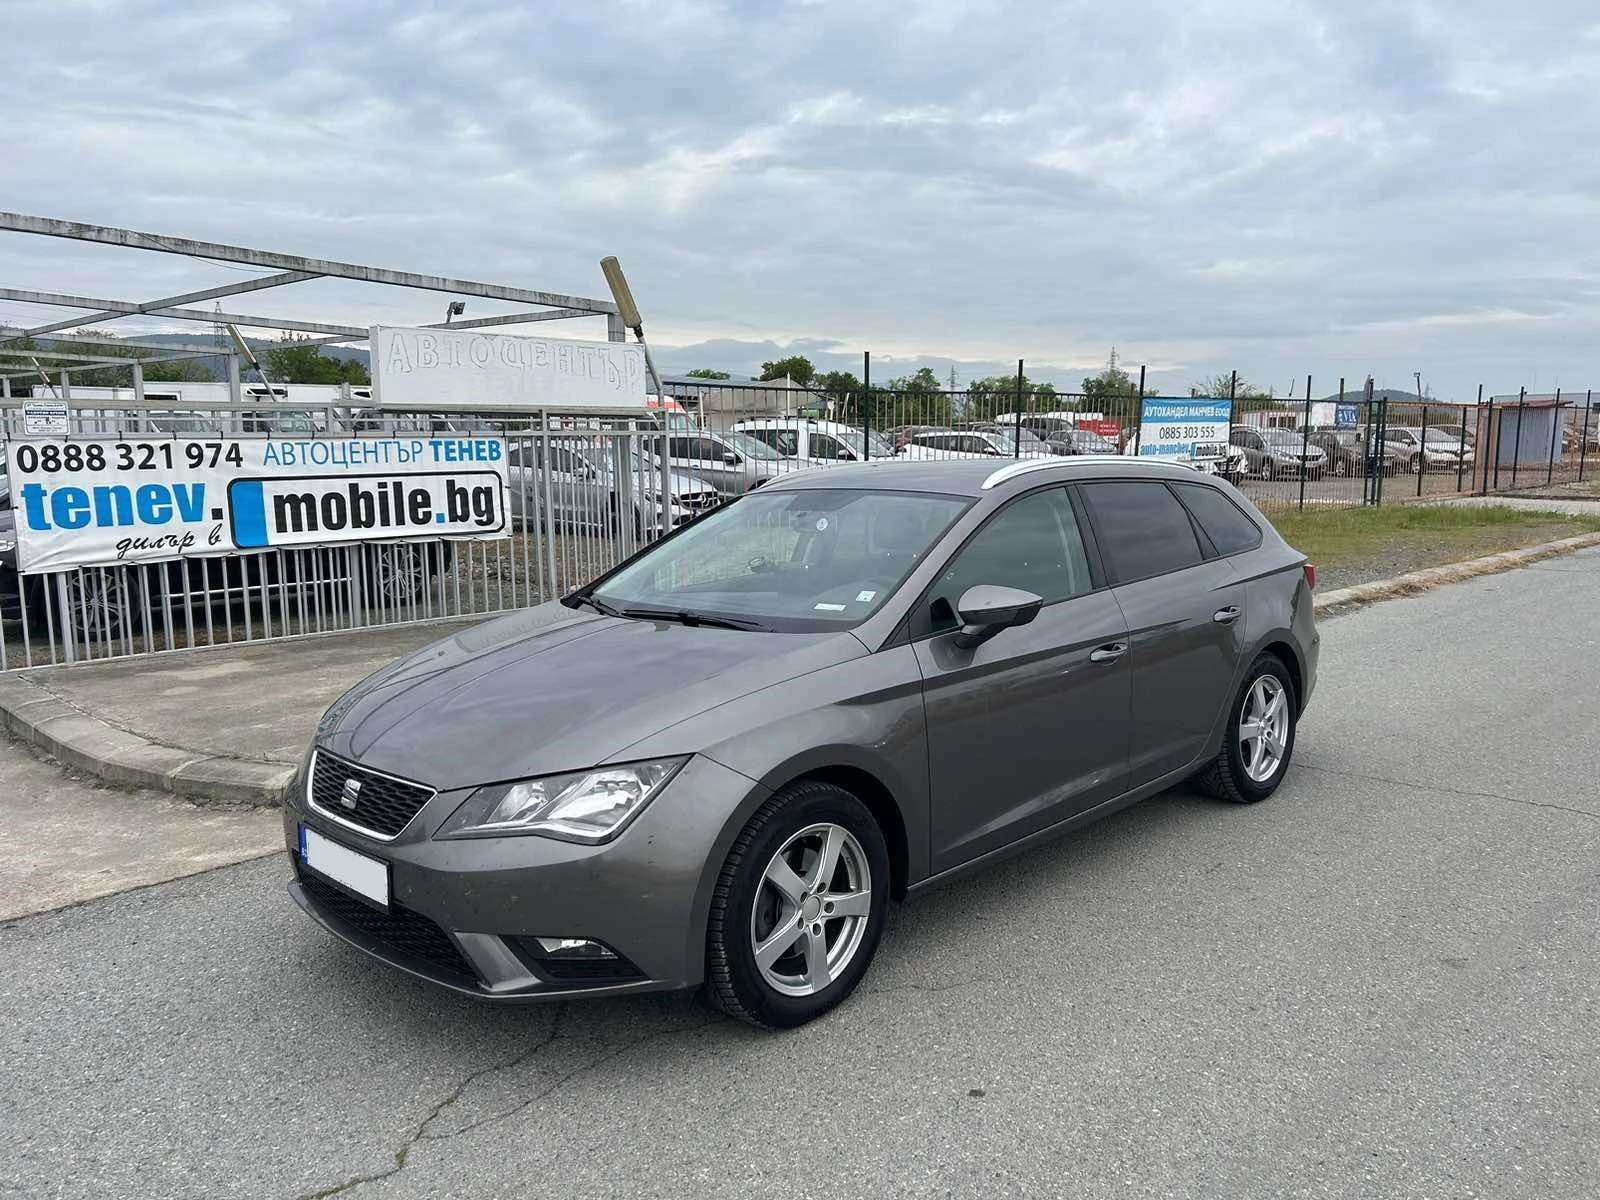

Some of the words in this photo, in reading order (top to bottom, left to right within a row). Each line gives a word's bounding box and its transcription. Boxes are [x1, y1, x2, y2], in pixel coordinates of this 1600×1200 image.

[386, 332, 642, 393] АВТОЦЕНТЪР
[1159, 427, 1181, 440] 0885
[1183, 427, 1199, 439] 303
[1200, 426, 1215, 438] 555
[16, 443, 107, 473] 0888
[115, 442, 174, 470] 321
[185, 442, 244, 469] 974
[263, 440, 423, 469] АВТОЦЕНТЪР
[429, 440, 502, 462] ТЕНЕВ
[273, 479, 496, 534] mobile.bg
[116, 530, 197, 560] дилър
[207, 522, 223, 546] в
